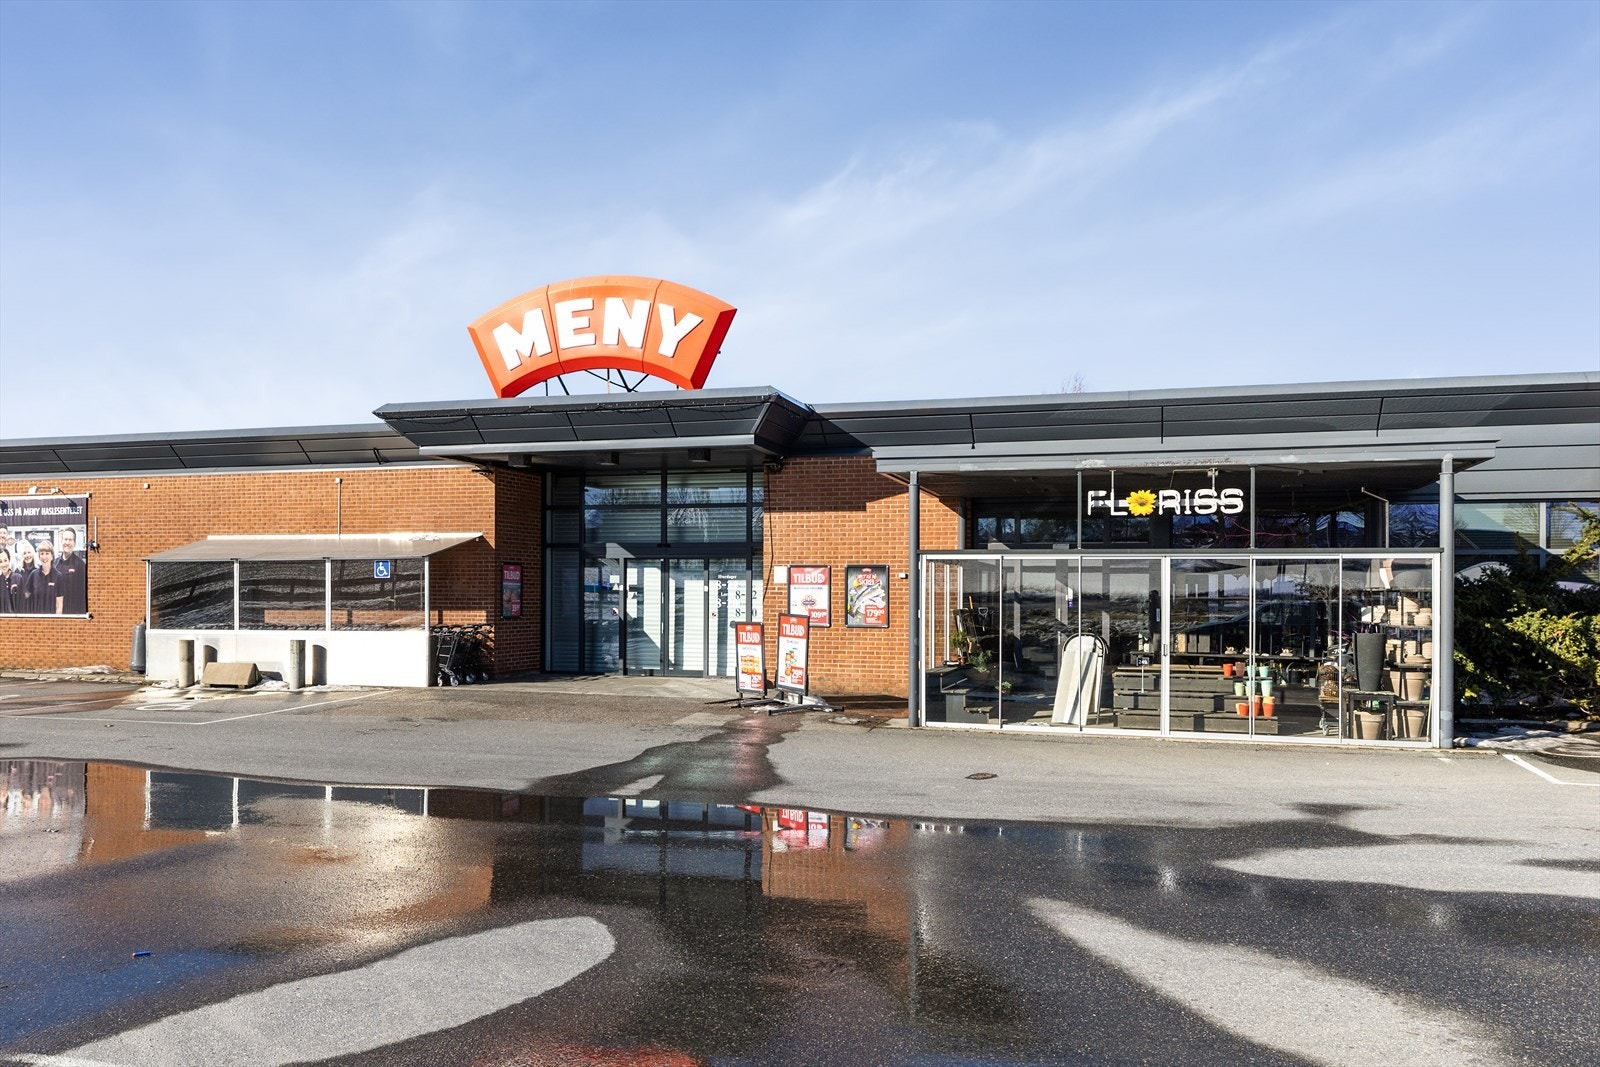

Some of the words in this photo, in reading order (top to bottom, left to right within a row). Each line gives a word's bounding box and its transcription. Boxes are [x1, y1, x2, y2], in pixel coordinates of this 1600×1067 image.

[492, 296, 704, 372] MENY
[15, 506, 23, 516] PÅ
[23, 507, 40, 516] MENY
[41, 506, 83, 516] HASLESENTERET
[503, 570, 521, 580] TILBUD
[793, 573, 826, 584] TILBUD
[783, 624, 805, 637] TILBUD
[739, 631, 760, 644] TILBUD
